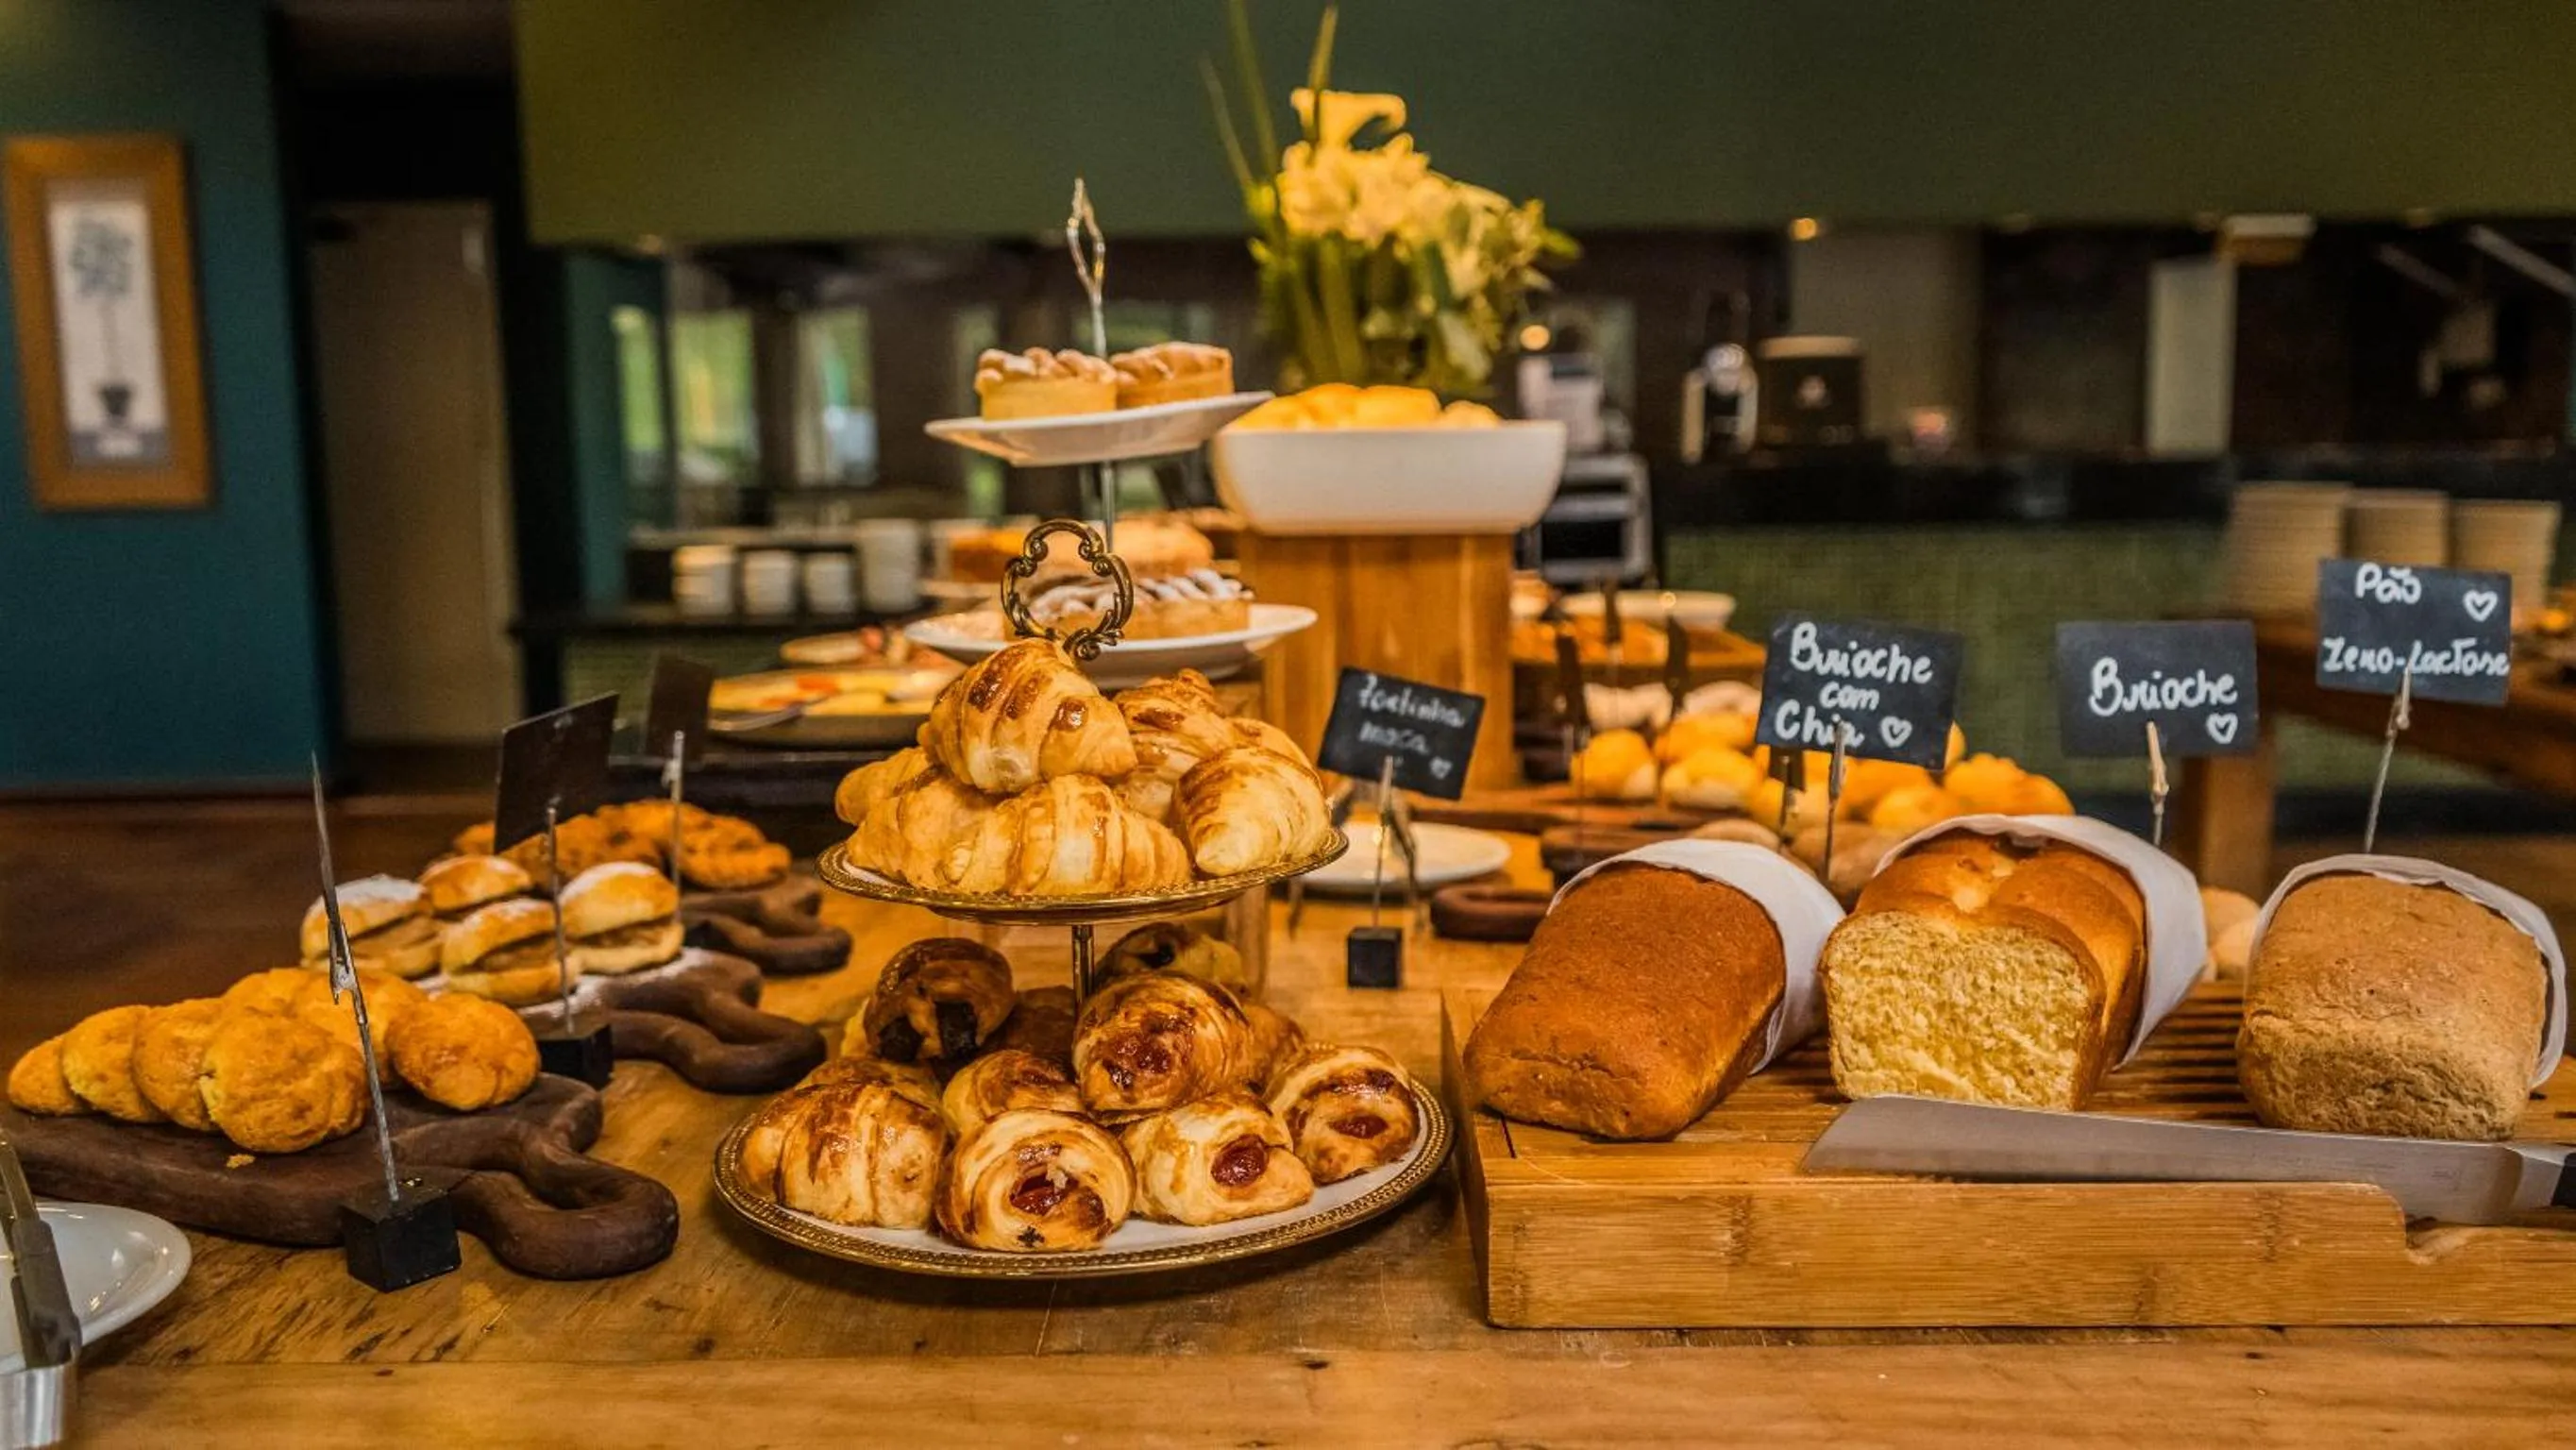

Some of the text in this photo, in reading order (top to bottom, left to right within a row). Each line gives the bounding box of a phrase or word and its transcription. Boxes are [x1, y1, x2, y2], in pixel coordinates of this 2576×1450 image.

[2355, 562, 2421, 604] Pão
[1791, 621, 1933, 683] Brioche
[1819, 681, 1879, 711] com
[2088, 656, 2238, 717] Brioche
